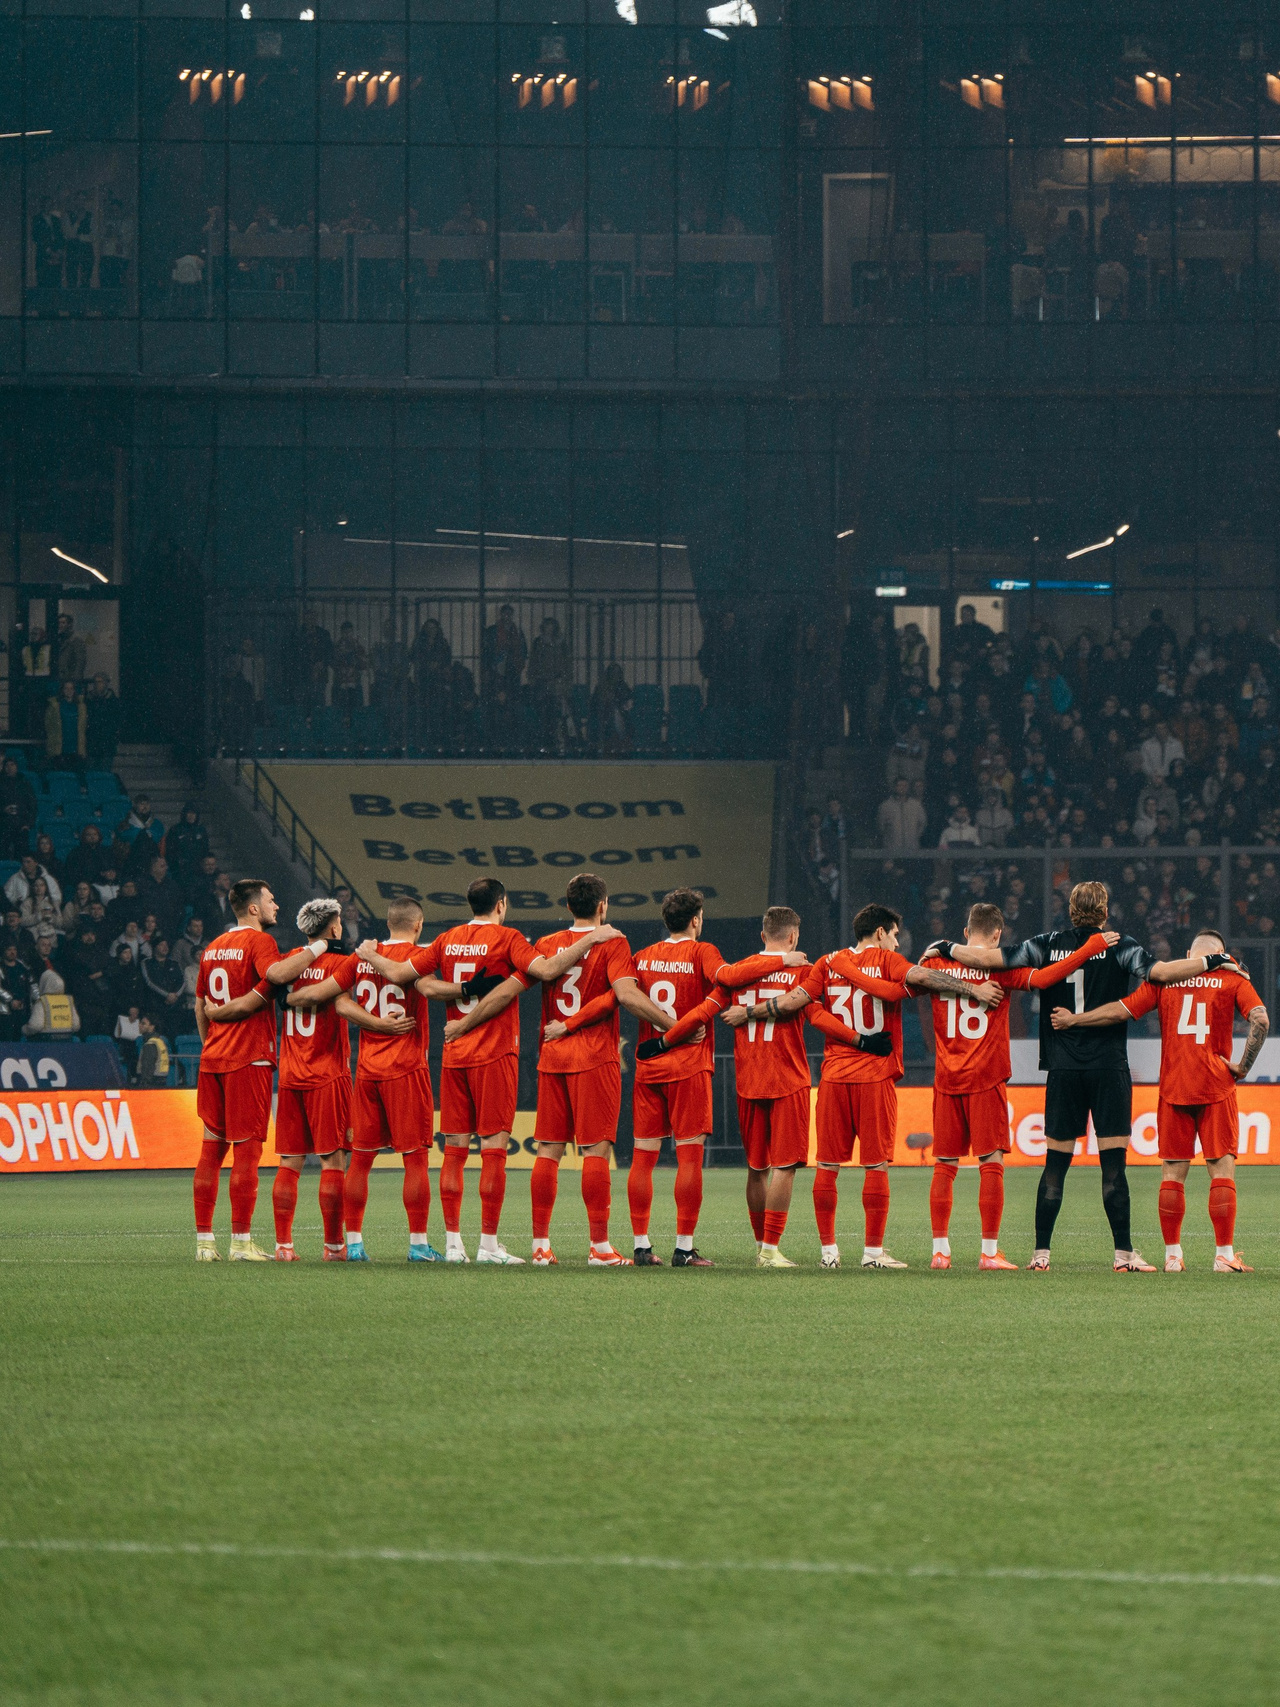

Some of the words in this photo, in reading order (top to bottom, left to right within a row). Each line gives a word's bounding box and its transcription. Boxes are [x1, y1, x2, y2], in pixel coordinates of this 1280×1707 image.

[350, 793, 687, 820] BetBoom
[362, 839, 702, 867] BetBoom
[376, 880, 718, 909] BeBom
[445, 944, 488, 956] OSIPENKO
[650, 961, 694, 974] MIRANCHUK
[209, 967, 230, 1005] 9
[356, 980, 405, 1020] 26
[453, 963, 479, 1014] 5
[556, 966, 583, 1017] 3
[649, 980, 677, 1033] 8
[1066, 969, 1085, 1014] 1
[738, 989, 786, 1043] 17
[827, 986, 884, 1036] 30
[940, 991, 989, 1040] 18
[1177, 994, 1211, 1044] 4
